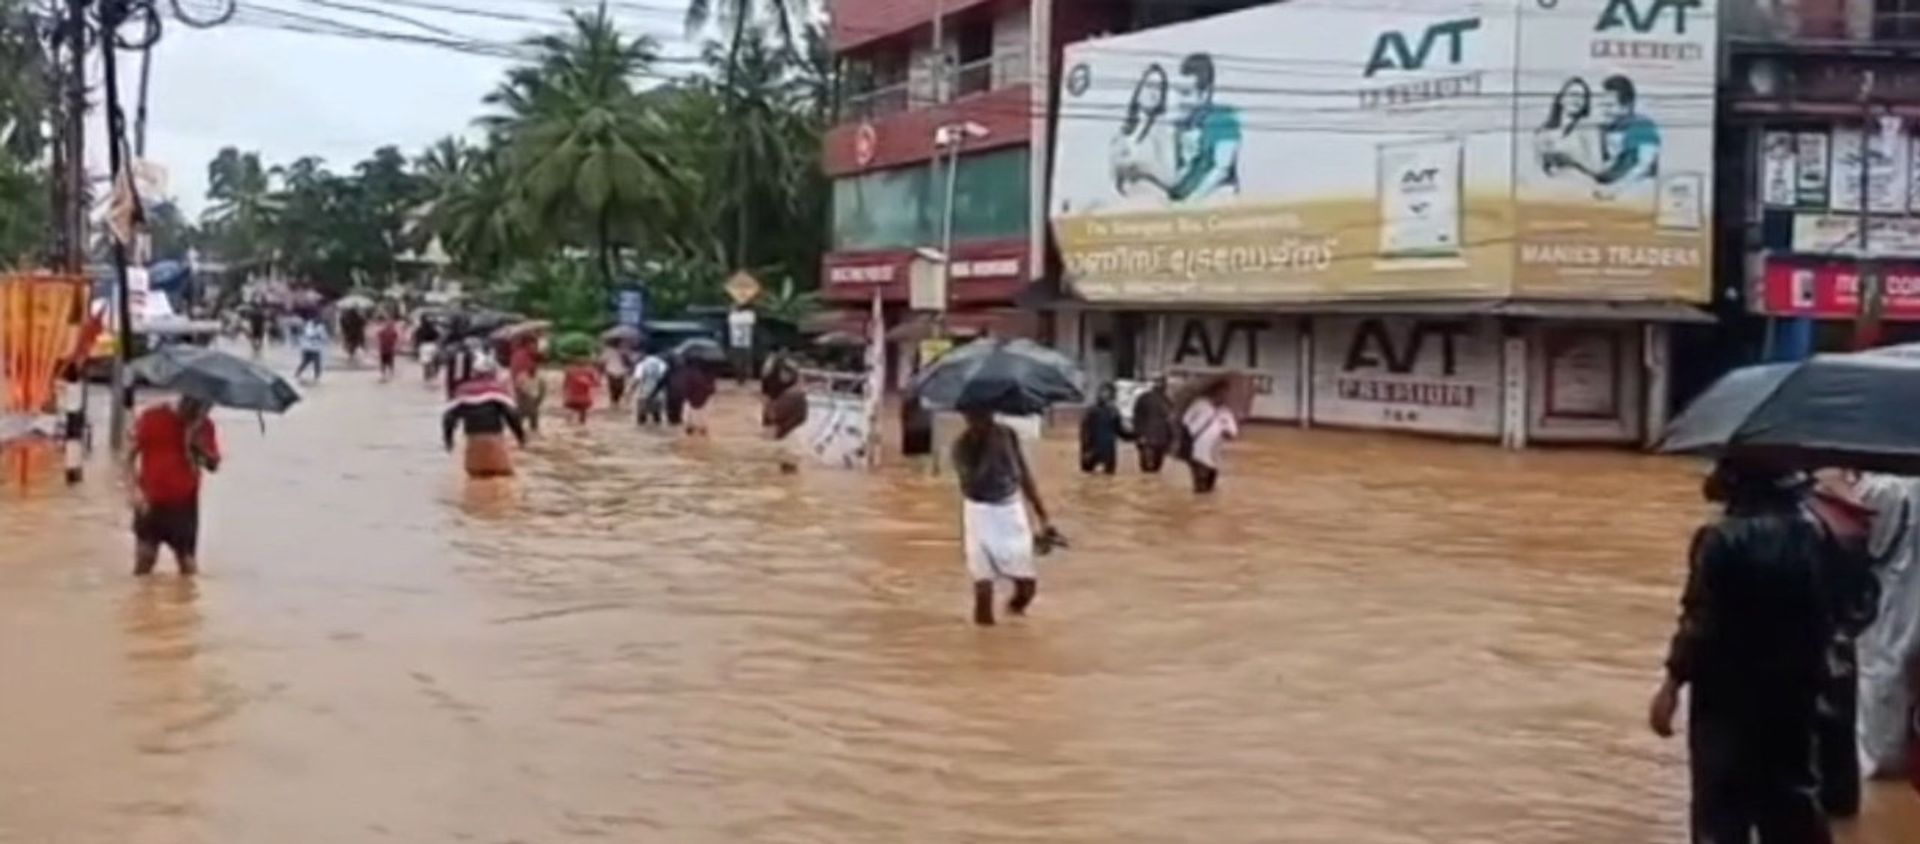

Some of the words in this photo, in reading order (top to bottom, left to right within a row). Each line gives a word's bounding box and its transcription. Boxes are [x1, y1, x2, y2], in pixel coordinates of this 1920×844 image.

[1594, 0, 1702, 33] AVT
[1363, 17, 1481, 78] AVT
[1173, 318, 1272, 367] AVT
[1343, 317, 1473, 376] AVT
